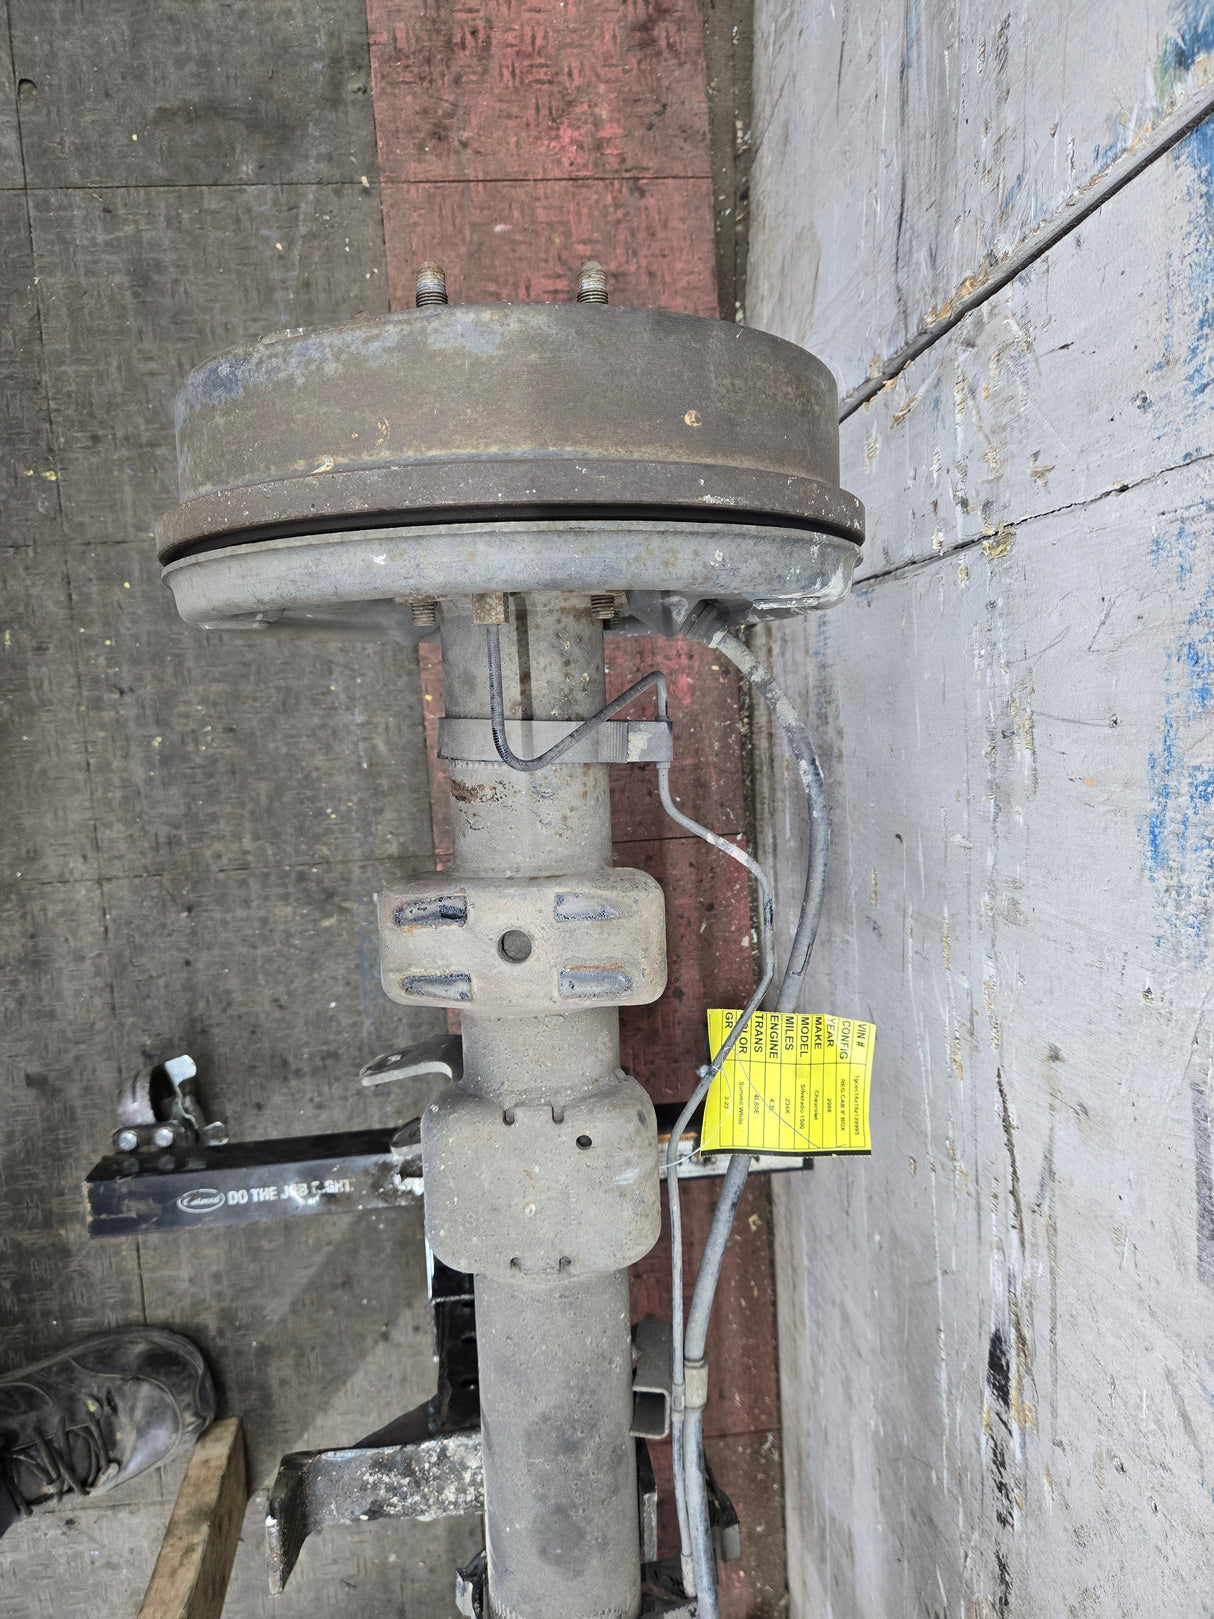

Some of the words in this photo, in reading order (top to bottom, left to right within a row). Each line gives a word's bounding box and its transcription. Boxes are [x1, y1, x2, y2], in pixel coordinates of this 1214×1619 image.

[725, 1012, 733, 1028] GR
[754, 1014, 764, 1053] TRANS
[770, 1015, 779, 1058] ENGINE
[785, 1016, 794, 1050] MILES
[800, 1016, 809, 1057] MODEL
[814, 1016, 822, 1050] MAKE
[827, 1018, 836, 1047] YEAR
[857, 1024, 867, 1039] VIN
[840, 1021, 851, 1059] CONFIG
[227, 1189, 249, 1206] DO
[251, 1186, 279, 1202] THE
